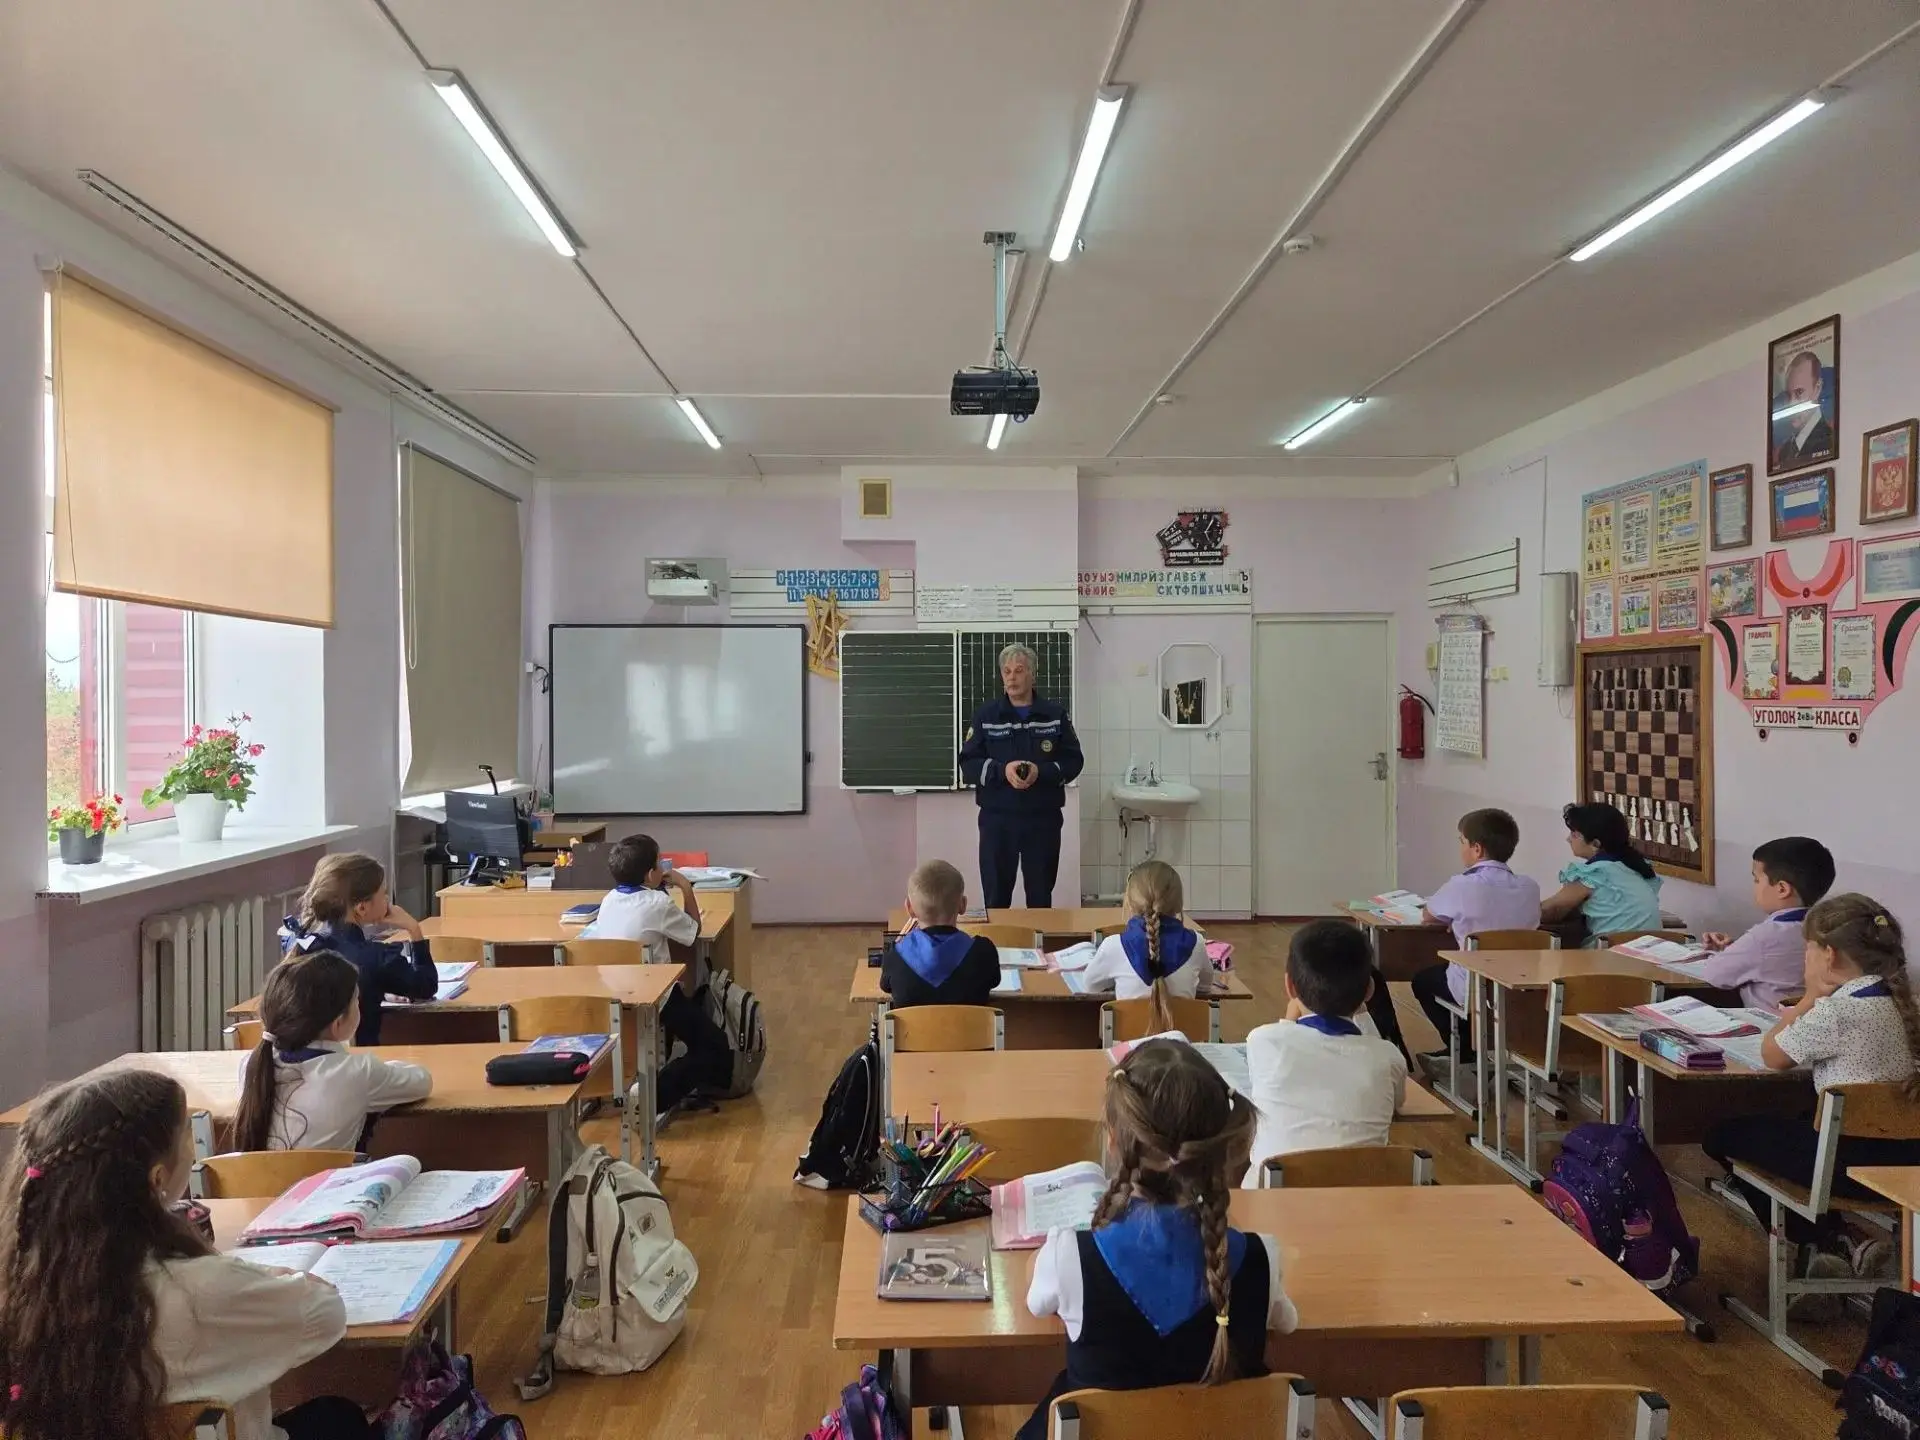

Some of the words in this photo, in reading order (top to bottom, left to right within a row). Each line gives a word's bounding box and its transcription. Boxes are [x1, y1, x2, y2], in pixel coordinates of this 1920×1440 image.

[778, 573, 784, 583] 0
[789, 573, 795, 583] 1
[800, 573, 806, 583] 2
[810, 573, 816, 583] 3
[820, 573, 827, 583] 4
[831, 573, 837, 583] 5
[841, 573, 847, 583] 6
[851, 573, 857, 583] 7
[861, 573, 867, 583] 8
[871, 573, 877, 583] 9
[1618, 574, 1629, 584] 112
[788, 588, 797, 600] 11
[820, 588, 828, 599] 14
[841, 588, 849, 599] 16
[851, 588, 859, 599] 17
[861, 588, 869, 599] 18
[871, 588, 879, 599] 19
[1748, 631, 1773, 640] ГРАМОТА
[1755, 709, 1796, 724] УГОЛОК
[1815, 710, 1859, 726] КЛАССА
